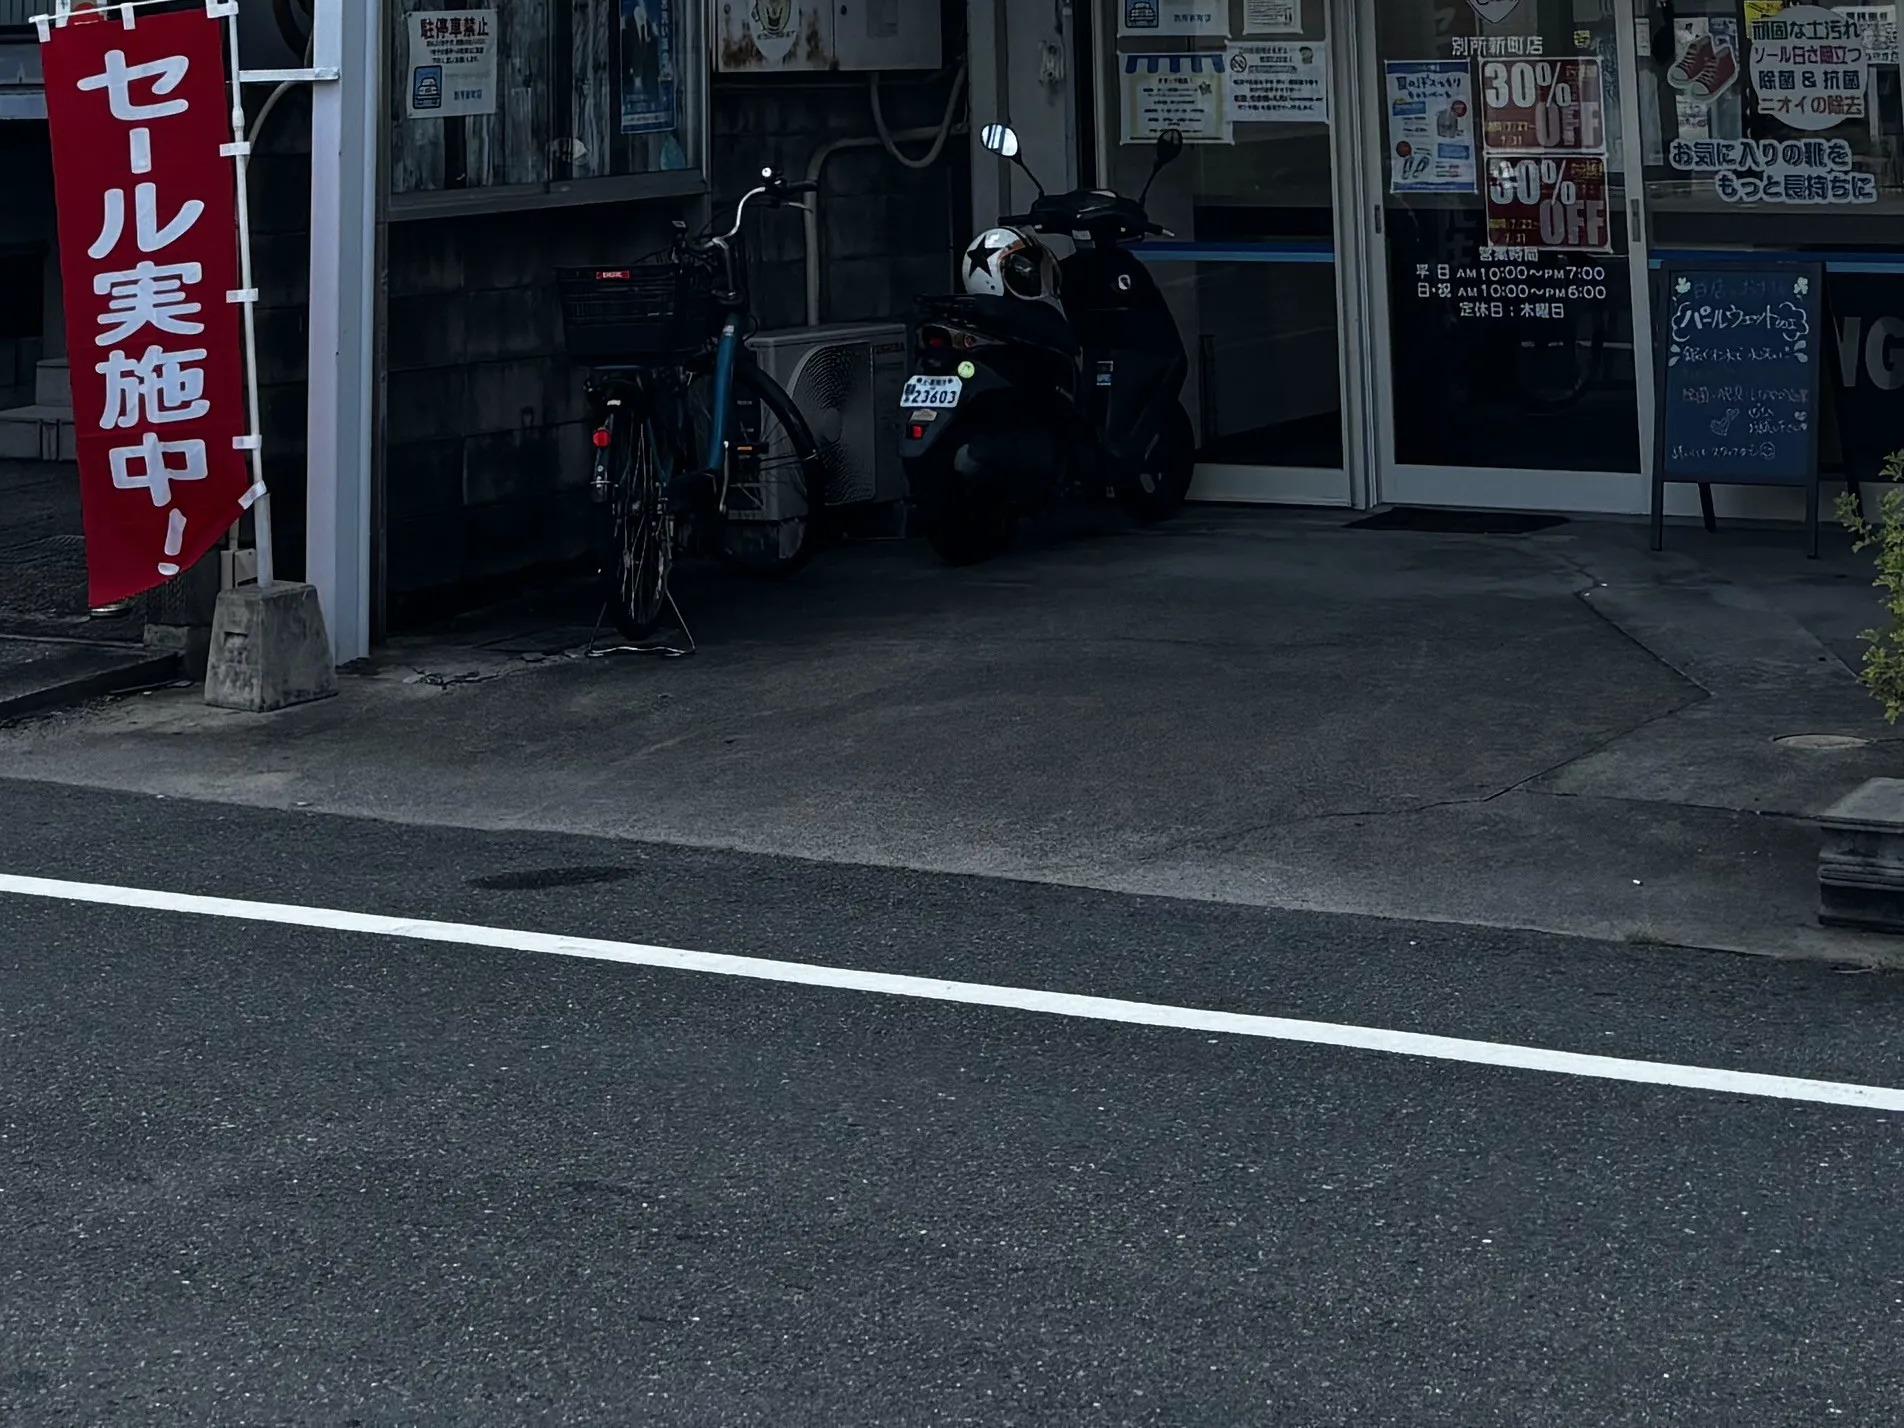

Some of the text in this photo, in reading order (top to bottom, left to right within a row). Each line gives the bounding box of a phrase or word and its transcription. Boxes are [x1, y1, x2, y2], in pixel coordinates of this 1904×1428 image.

[1452, 35, 1543, 57] 別所新町店
[1484, 61, 1571, 108] 30%
[1536, 101, 1599, 147] OFF
[1718, 174, 1874, 200] もっと長持ちに
[1539, 198, 1604, 245] OFF
[911, 390, 956, 404] 23603
